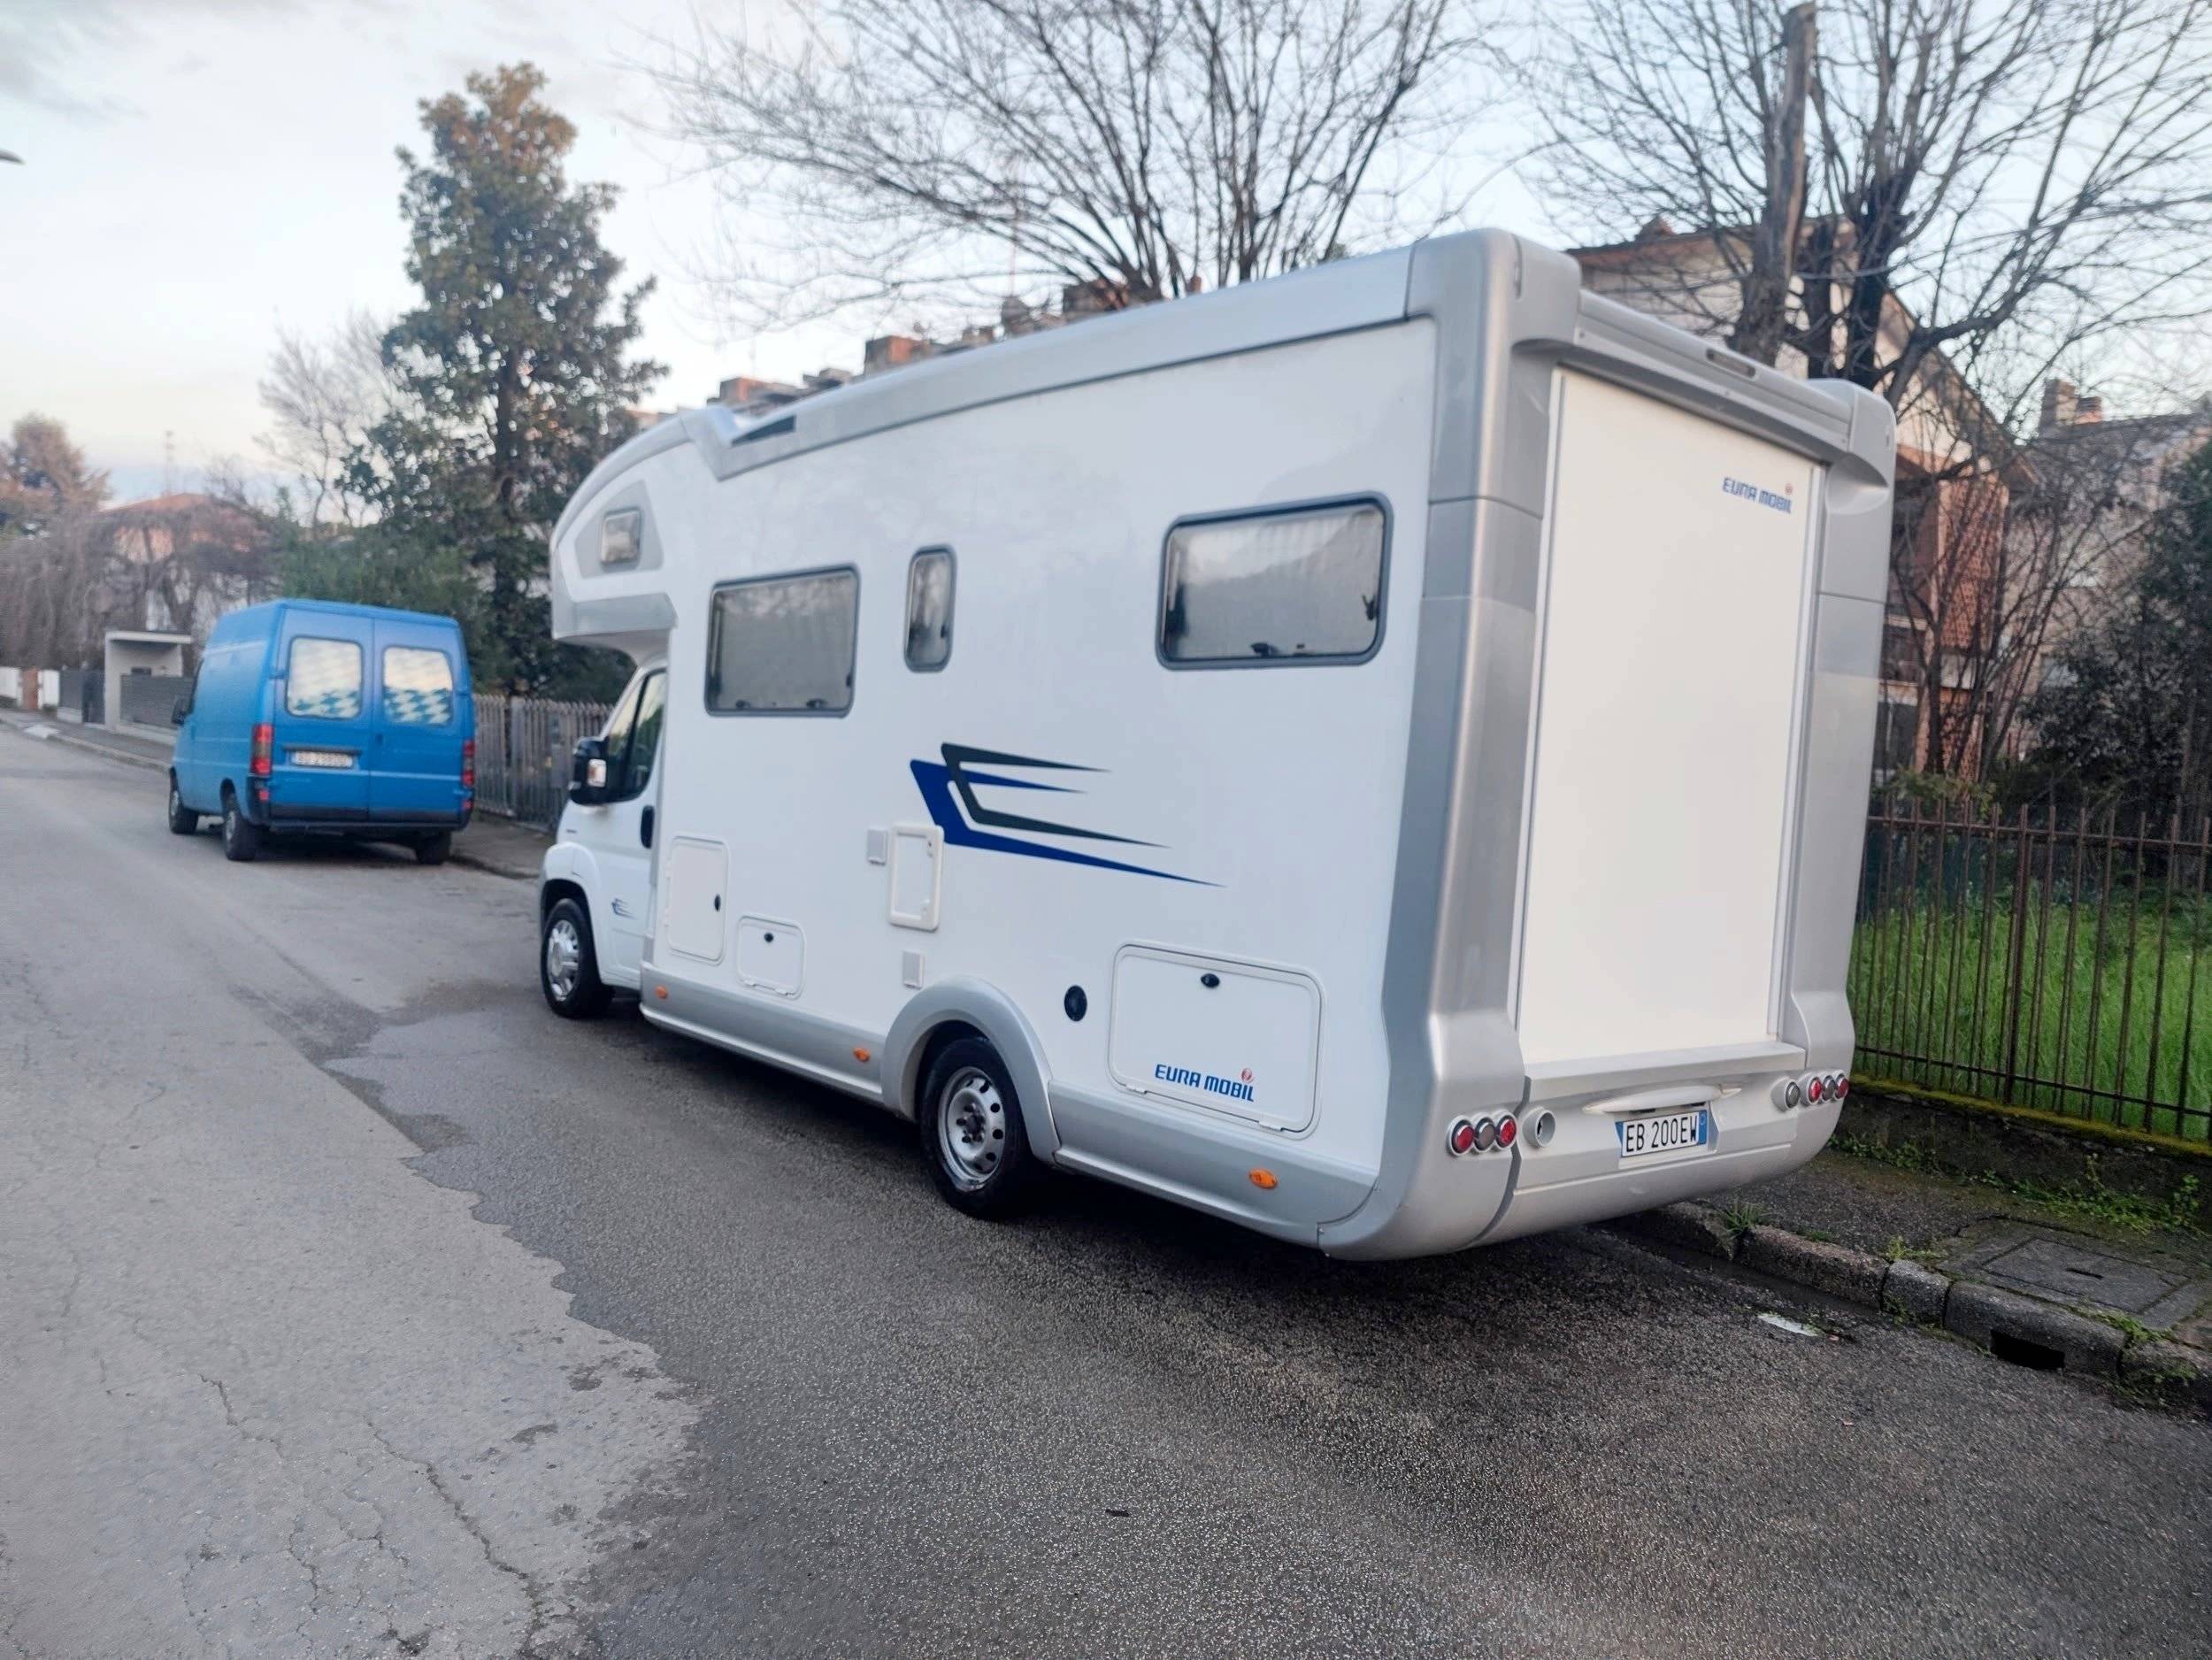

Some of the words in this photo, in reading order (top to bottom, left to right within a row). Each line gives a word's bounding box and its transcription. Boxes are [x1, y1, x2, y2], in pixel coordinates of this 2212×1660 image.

[1155, 1064, 1201, 1087] EURA
[1203, 1075, 1254, 1103] MOBIL
[1626, 1123, 1645, 1152] EB
[1651, 1116, 1697, 1148] 200EW
